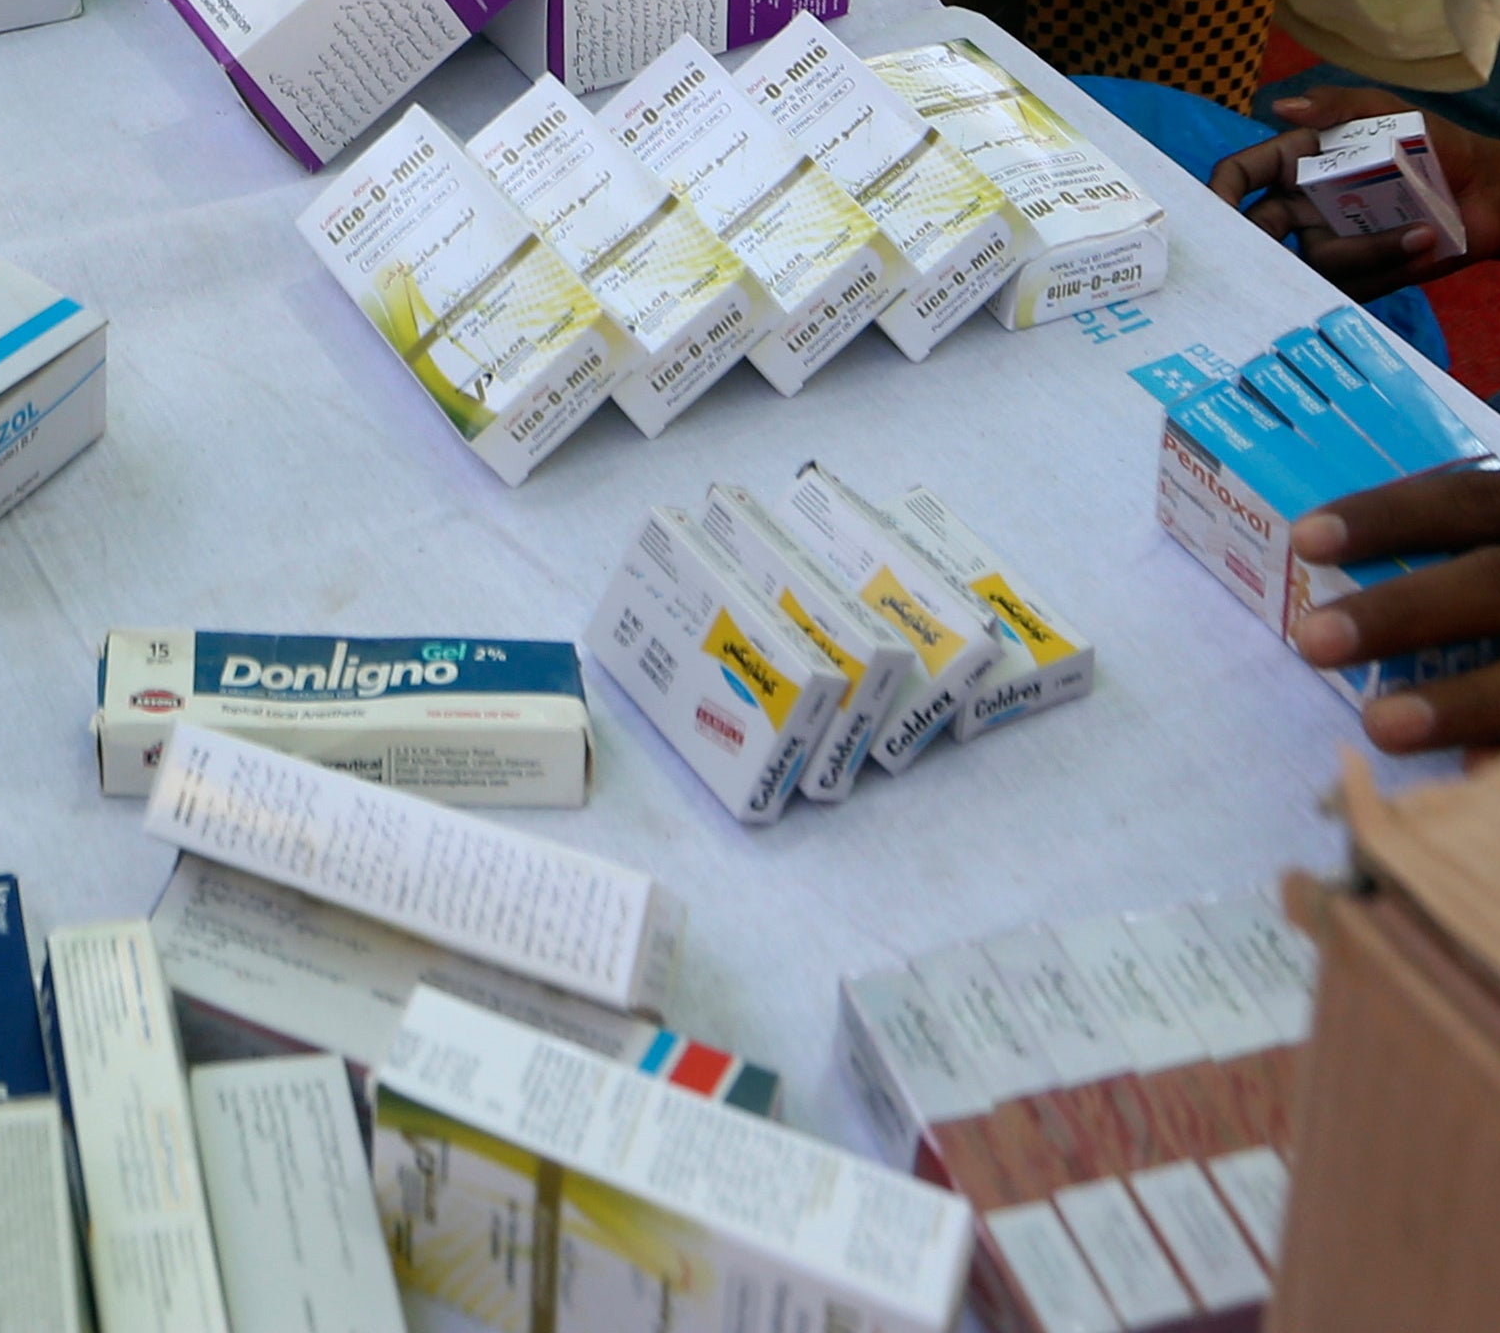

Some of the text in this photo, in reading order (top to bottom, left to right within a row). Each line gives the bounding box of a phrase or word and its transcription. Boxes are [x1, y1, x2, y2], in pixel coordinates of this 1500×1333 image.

[323, 138, 438, 246] Lice-O-Mite
[1025, 179, 1132, 222] Lice-O-Mi
[916, 237, 1007, 320] Lice-O-Mite
[1047, 262, 1143, 300] Lice-O-Mite
[786, 271, 879, 354] Lice-O-Mite
[487, 334, 529, 373] VALOR
[650, 307, 745, 395] Lice-O-Mite
[1307, 339, 1364, 390] Pentoxol
[1353, 317, 1401, 373] Pentoxol
[507, 350, 604, 444] Lice-O-Mite
[1223, 385, 1281, 431] Pentoxol
[1271, 362, 1327, 416] Pentoxol
[1198, 402, 1255, 452] Pentoxol
[1163, 432, 1271, 542] Pentoxol
[148, 641, 170, 658] 15
[220, 640, 460, 699] Donligno
[422, 643, 508, 663] Gel 2%
[885, 688, 955, 758] Coldrex
[973, 677, 1044, 718] Coldrex
[750, 735, 804, 814] Coldrex
[819, 712, 873, 792] Coldrex
